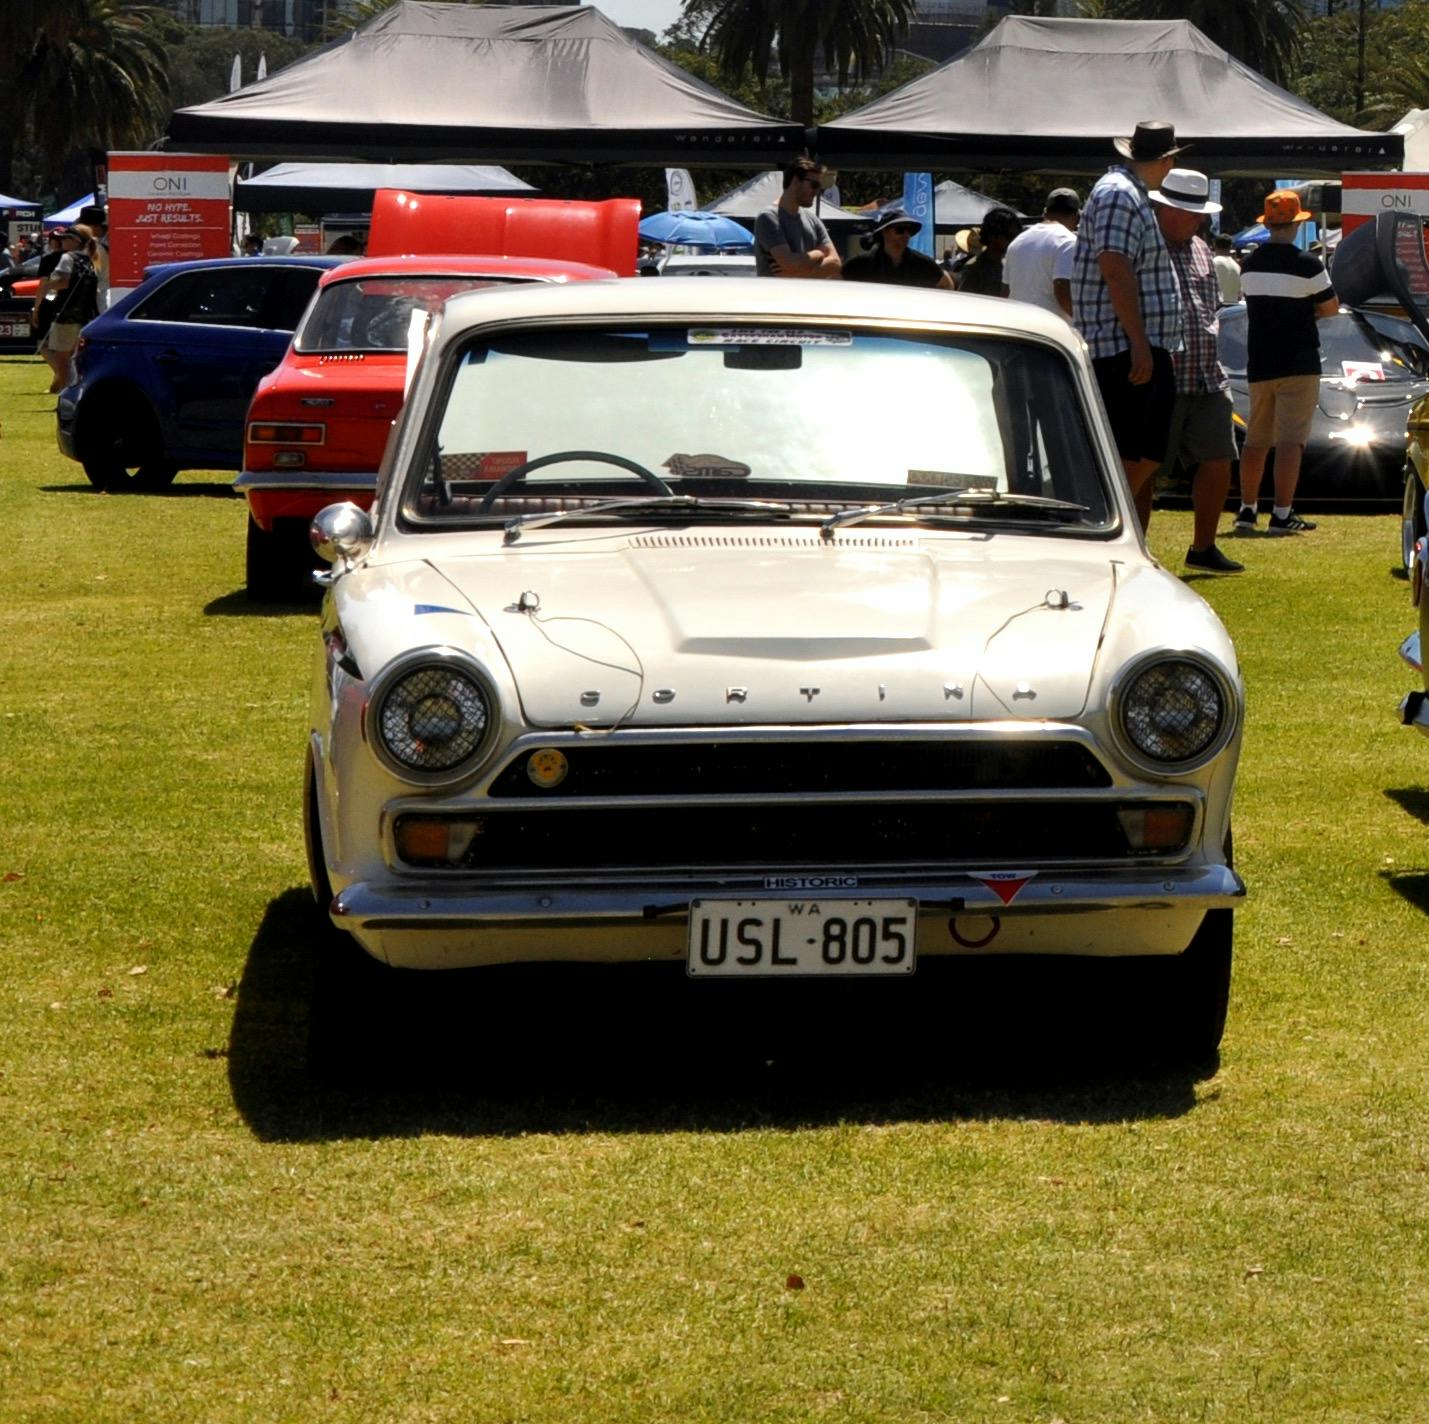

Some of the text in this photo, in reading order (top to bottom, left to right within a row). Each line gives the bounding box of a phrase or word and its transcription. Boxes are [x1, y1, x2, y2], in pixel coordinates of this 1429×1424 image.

[153, 177, 187, 191] ONI
[148, 203, 163, 212] NO
[1381, 194, 1412, 208] ONI
[579, 681, 1038, 708] CORTINA
[765, 877, 858, 888] HISTORIC
